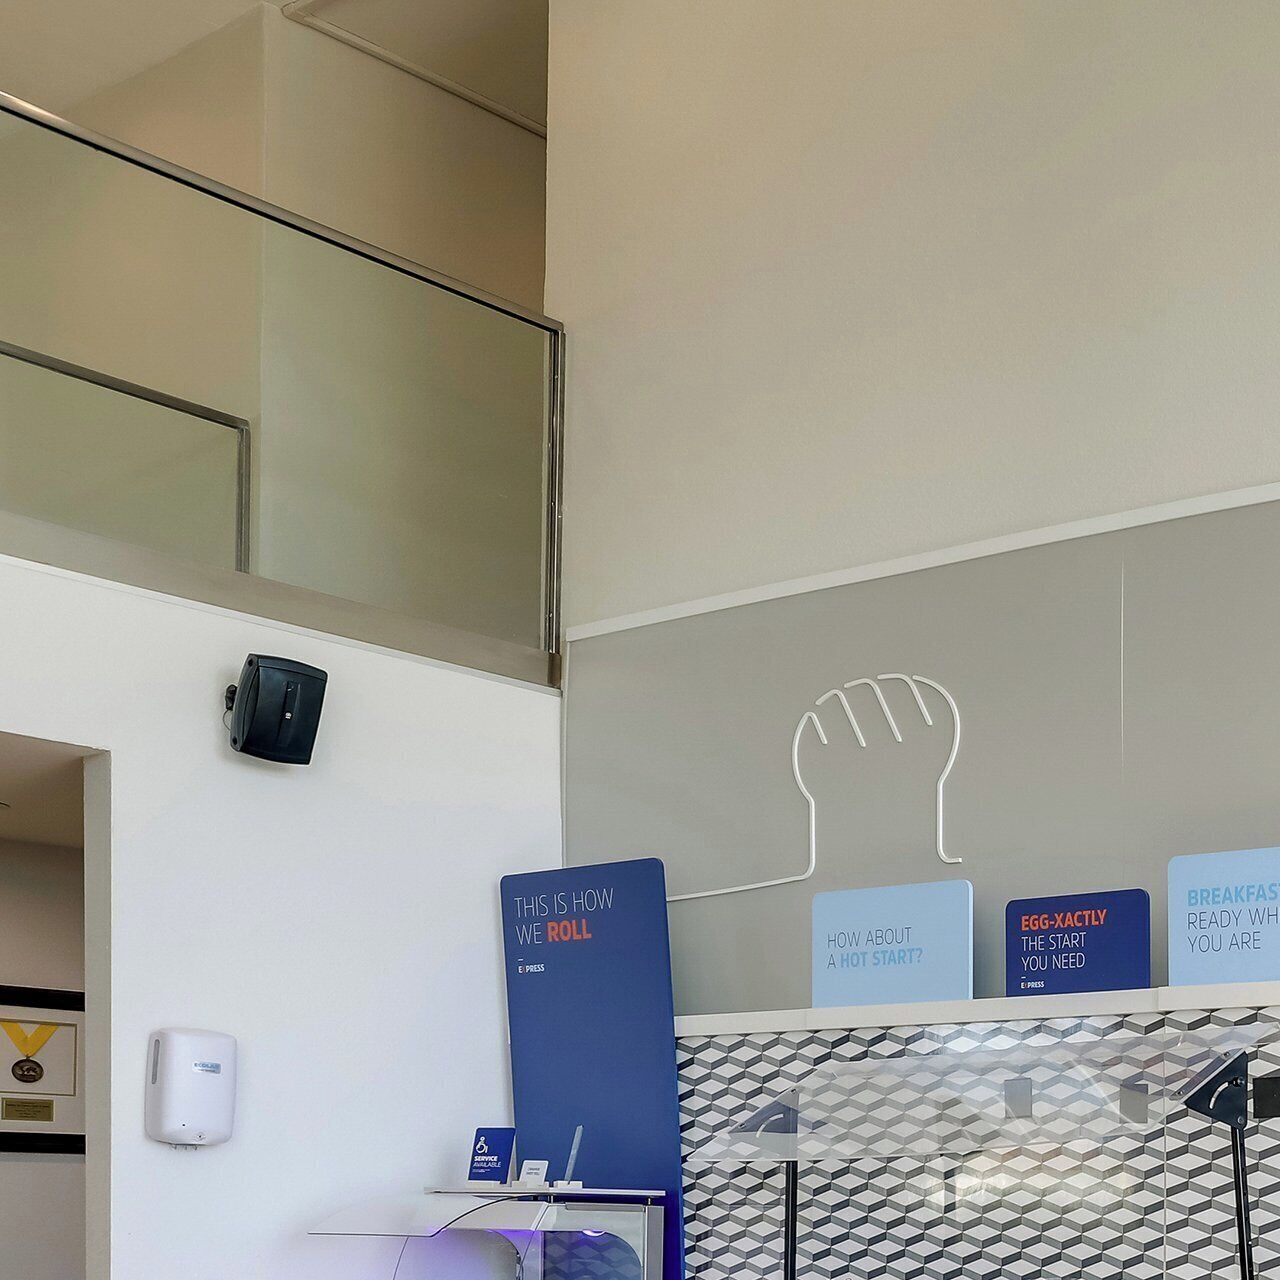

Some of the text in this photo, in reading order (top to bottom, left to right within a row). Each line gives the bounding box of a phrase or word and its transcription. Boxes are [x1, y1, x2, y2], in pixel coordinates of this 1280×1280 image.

[514, 887, 614, 918] THIS IS HOW
[1021, 908, 1107, 931] EGG-XACTLY
[1187, 909, 1242, 930] READY
[515, 918, 592, 946] WE ROLL
[827, 926, 912, 948] HOW ABOUT
[1021, 931, 1087, 952] THE START
[1187, 931, 1261, 953] YOU ARE
[827, 947, 923, 969] A HOT START?
[1021, 952, 1086, 971] YOU NEED
